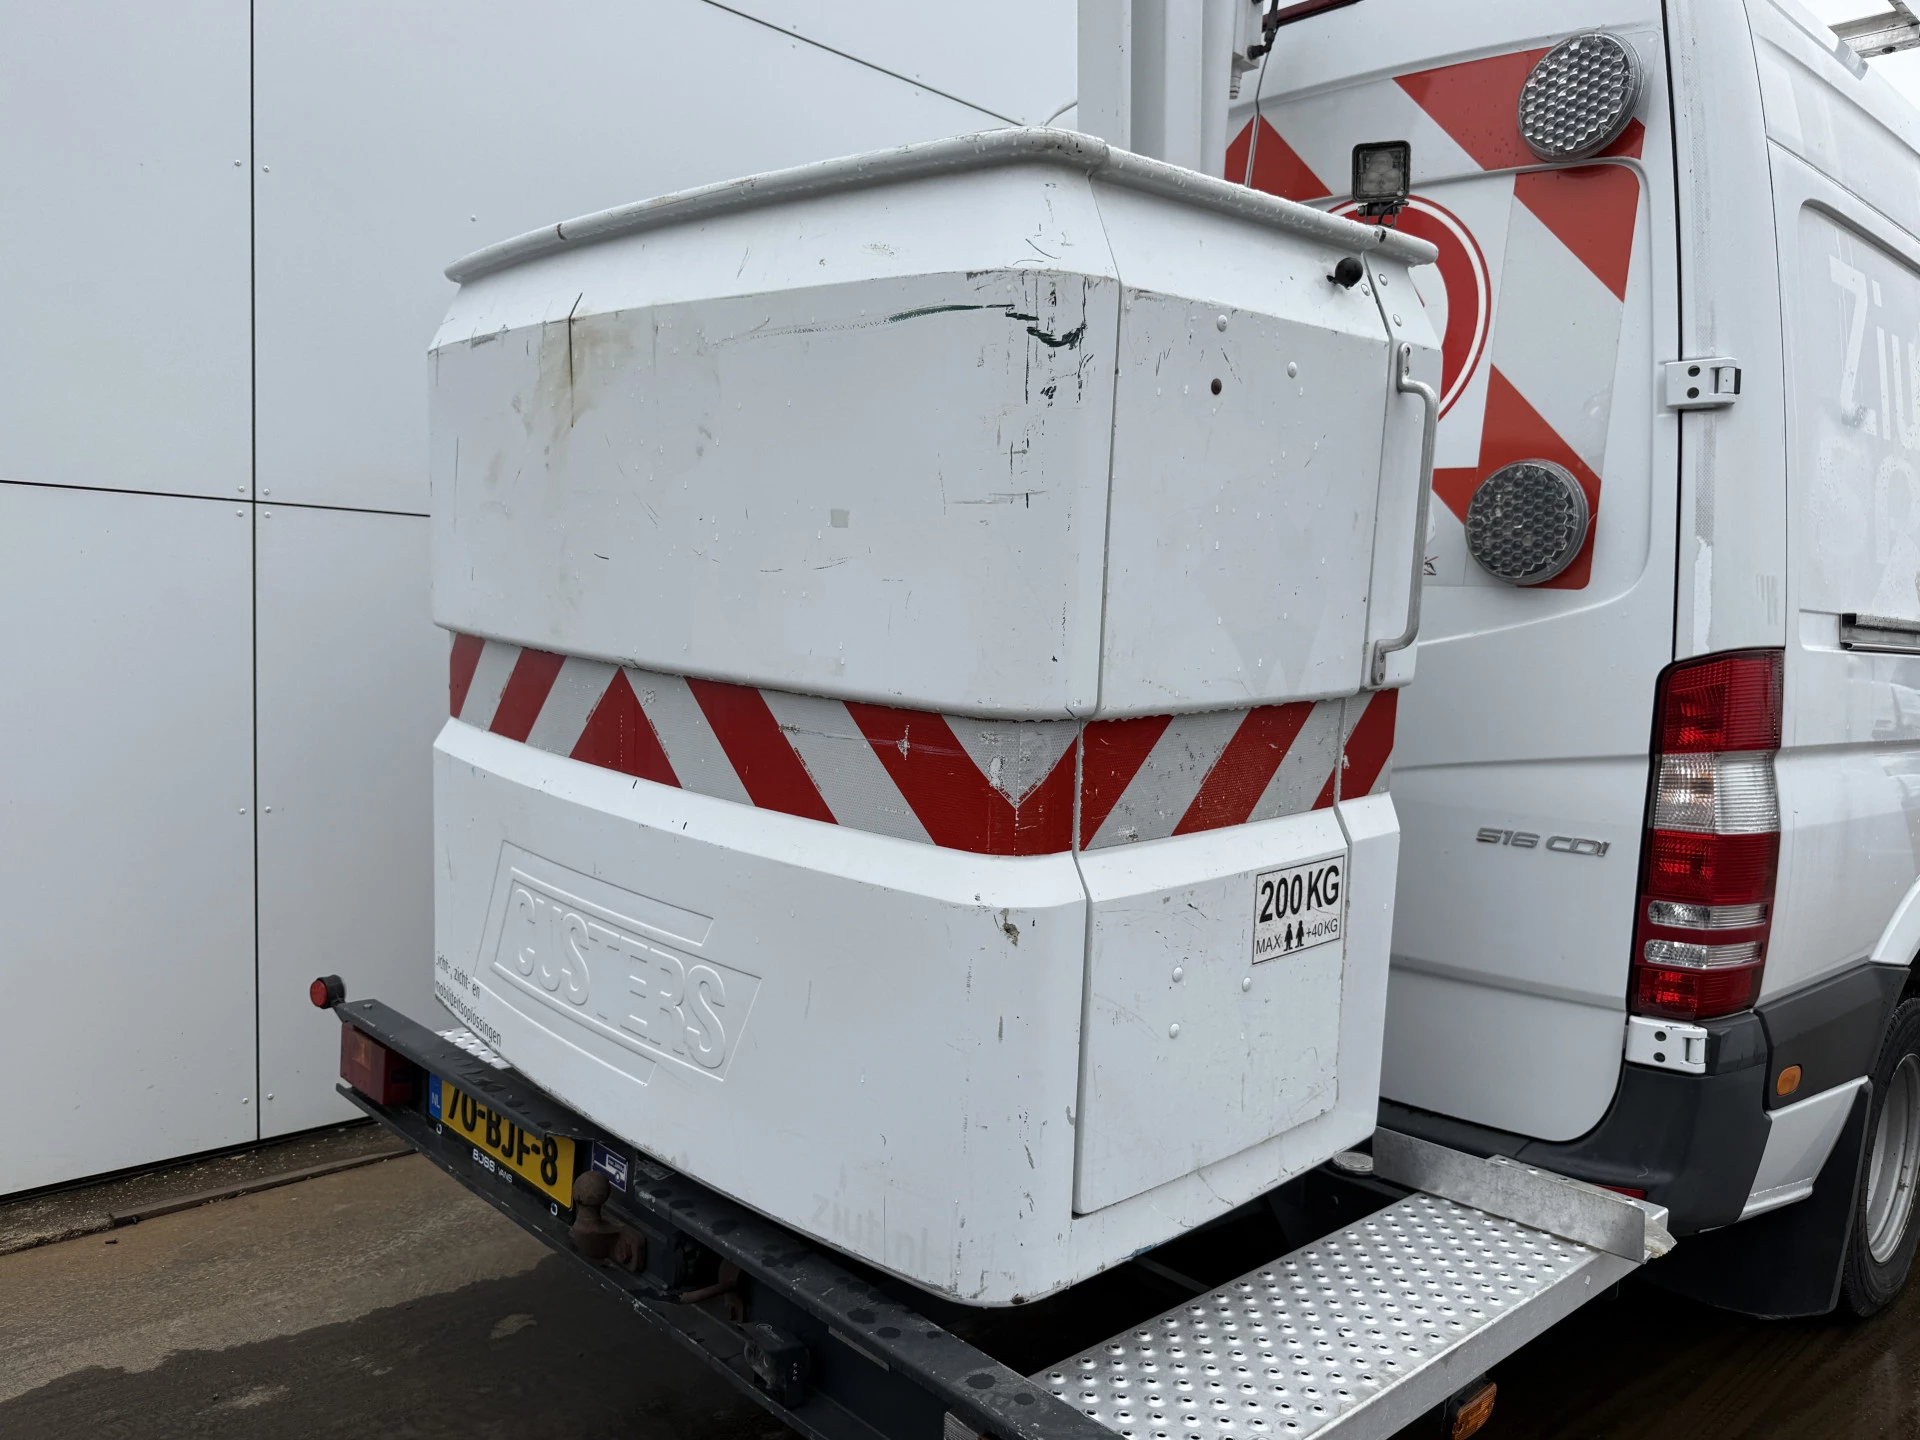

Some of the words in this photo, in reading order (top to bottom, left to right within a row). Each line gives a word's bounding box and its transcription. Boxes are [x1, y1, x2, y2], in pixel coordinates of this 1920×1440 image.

[1476, 827, 1540, 849] 516
[1546, 835, 1611, 857] CDI
[1259, 874, 1303, 924] 200
[1306, 865, 1340, 911] KG
[1255, 933, 1282, 955] MAX
[472, 983, 480, 999] en
[431, 1091, 441, 1109] NL
